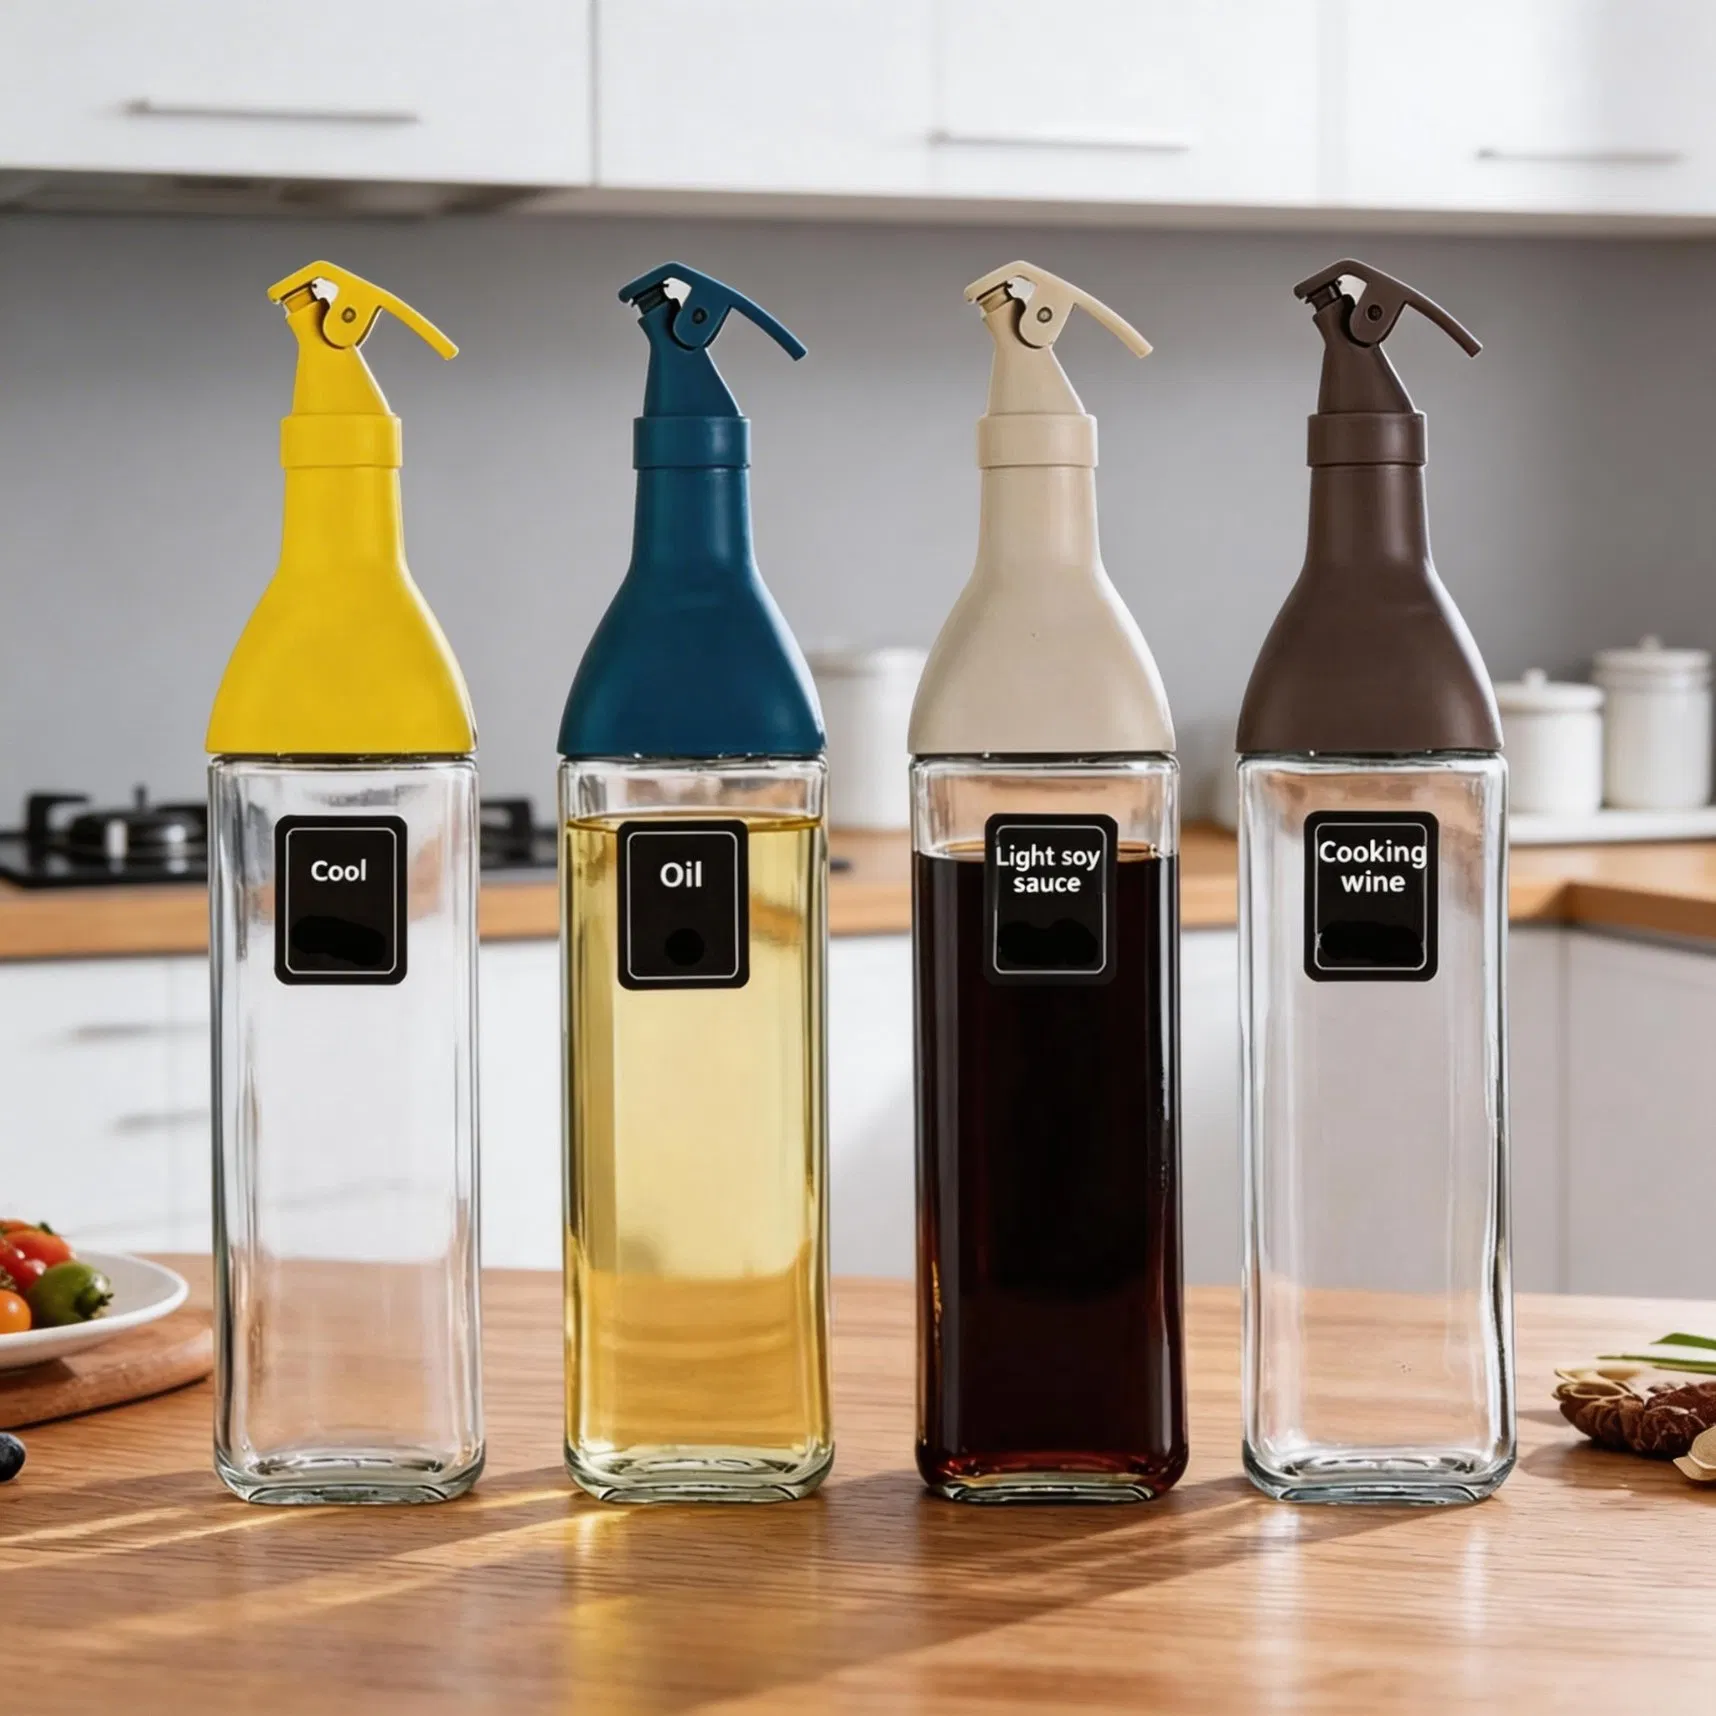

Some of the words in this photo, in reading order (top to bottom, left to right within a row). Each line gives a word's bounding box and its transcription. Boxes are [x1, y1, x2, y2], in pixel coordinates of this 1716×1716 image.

[996, 843, 1056, 872] Light
[1061, 850, 1101, 873] soy
[1318, 838, 1428, 868] Cooking
[310, 859, 367, 883] Cool
[659, 860, 703, 889] Oil
[1340, 869, 1406, 894] wine
[1013, 876, 1082, 894] sauce
